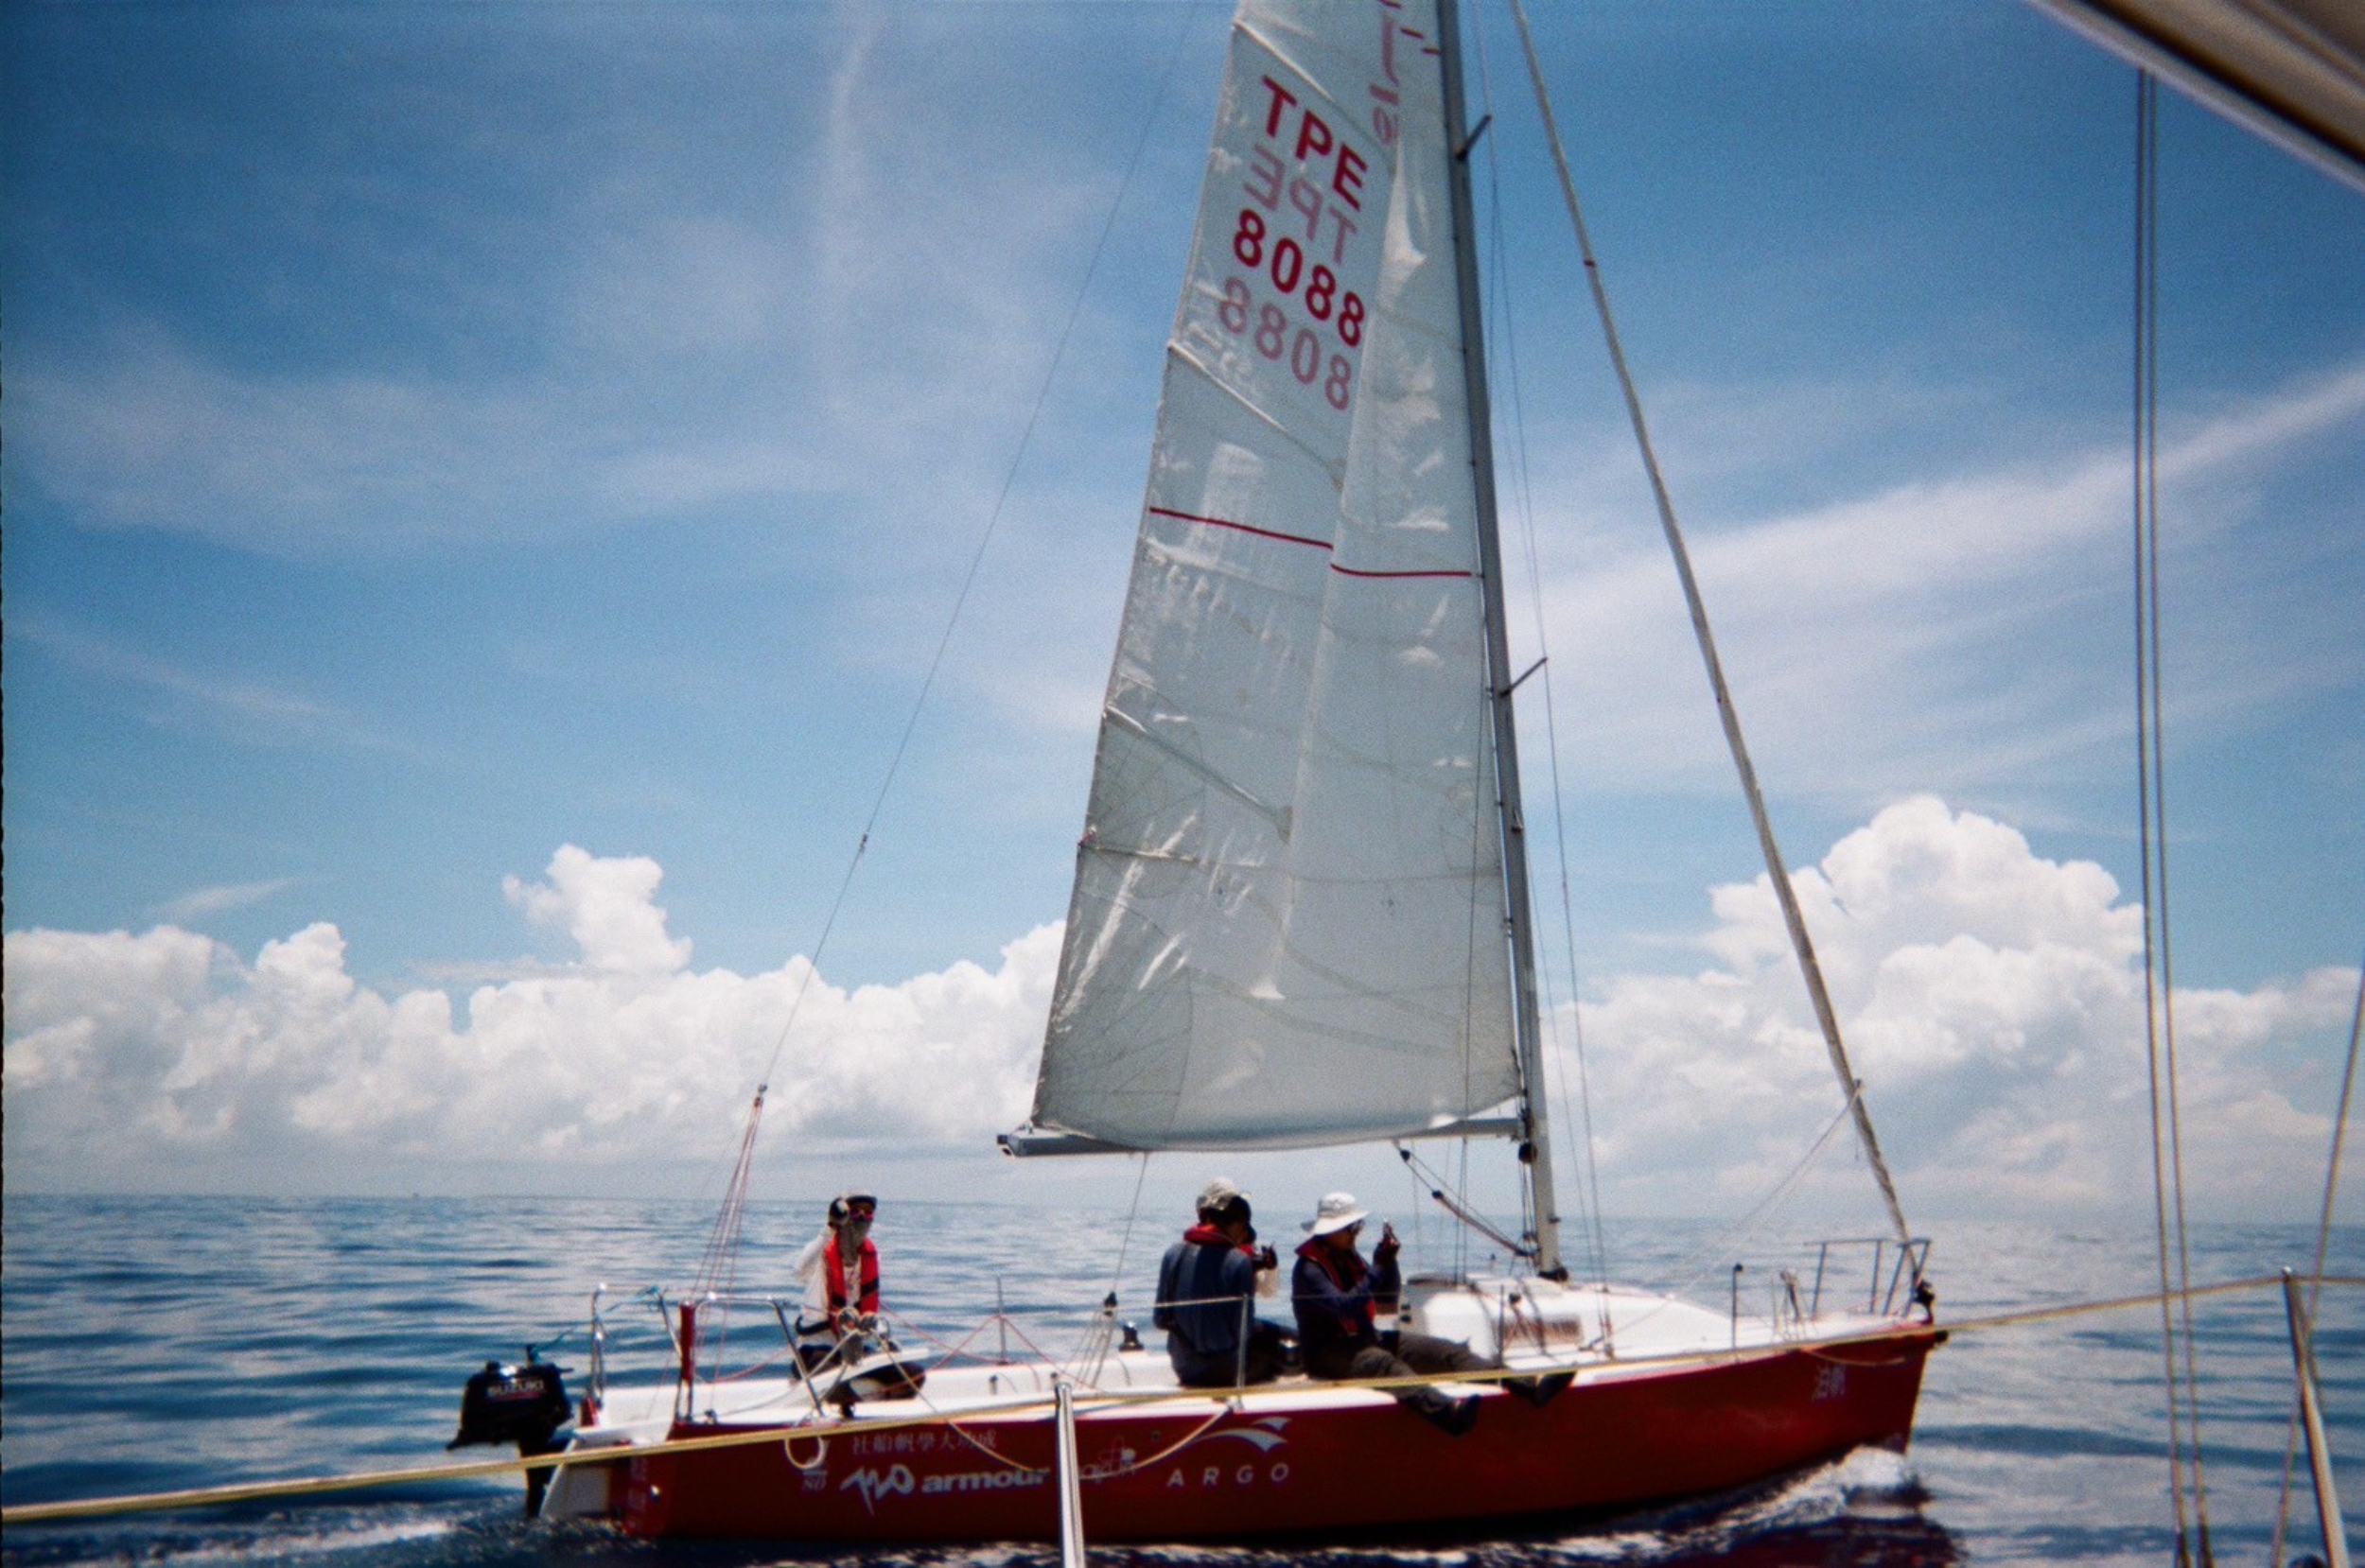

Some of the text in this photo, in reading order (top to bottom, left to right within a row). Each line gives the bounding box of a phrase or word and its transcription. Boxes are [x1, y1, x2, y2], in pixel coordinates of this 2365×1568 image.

[1261, 75, 1368, 212] TPE
[1233, 209, 1365, 348] 8088
[920, 1466, 1051, 1494] armour
[1165, 1462, 1290, 1488] ARGO
